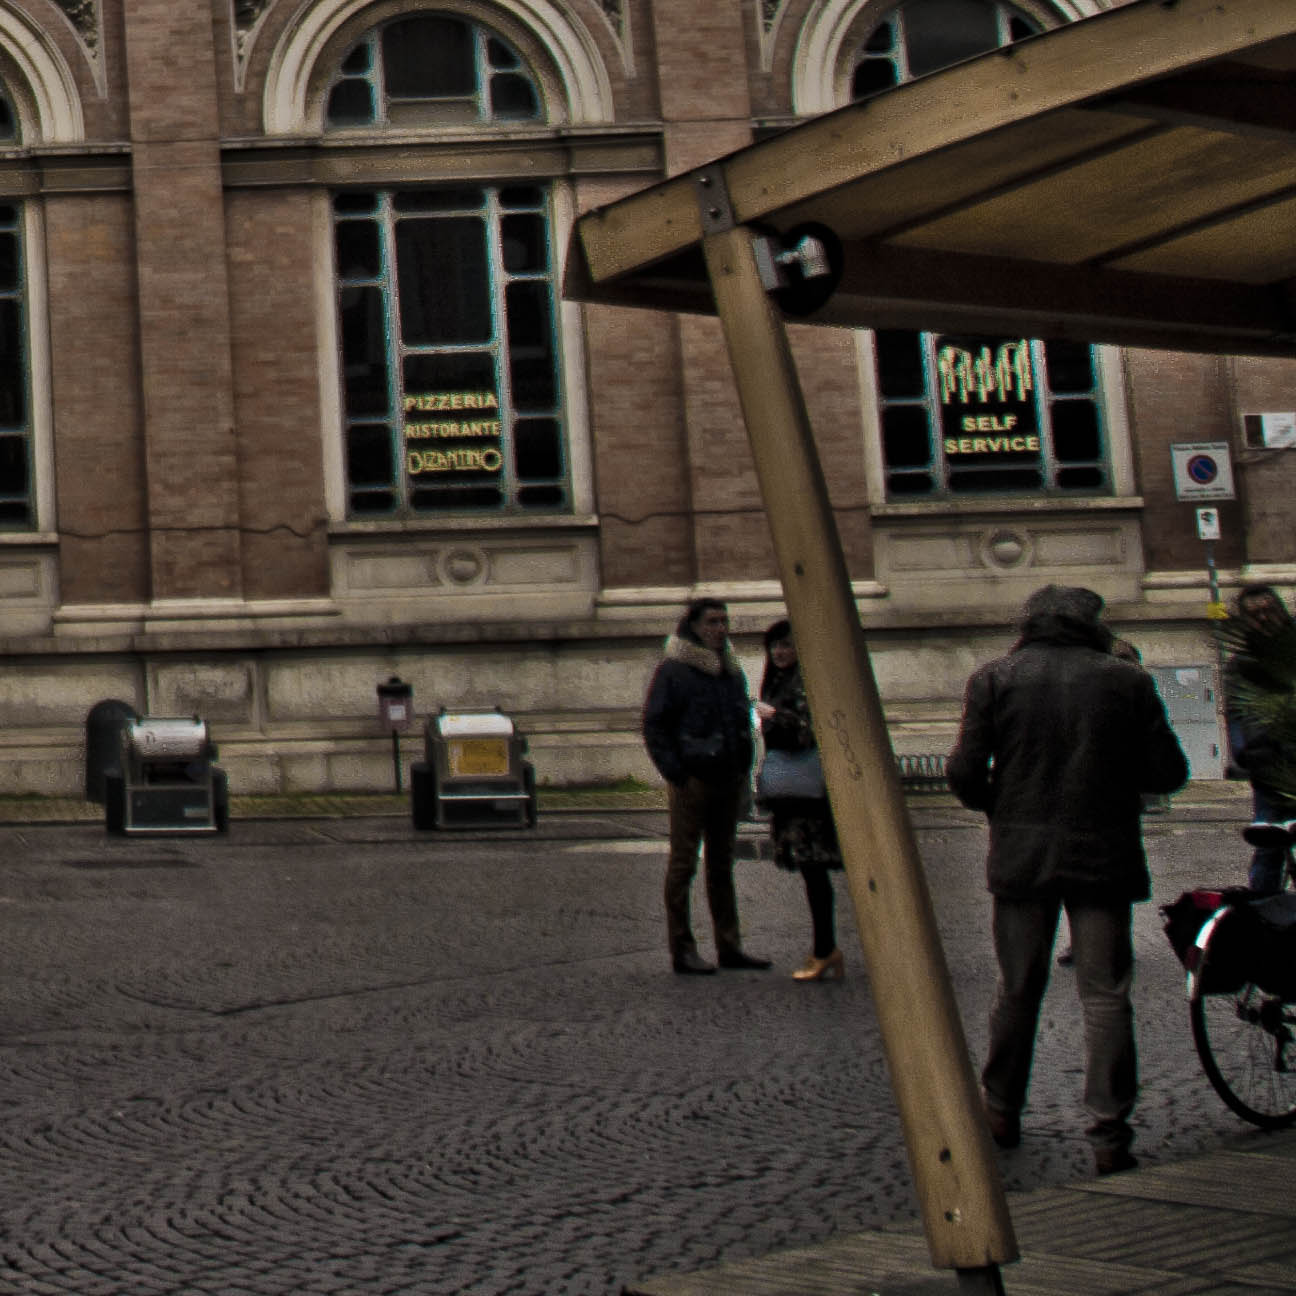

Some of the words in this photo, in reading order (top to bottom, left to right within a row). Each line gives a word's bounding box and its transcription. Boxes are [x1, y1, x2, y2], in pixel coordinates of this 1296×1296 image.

[405, 392, 498, 411] PIZZERIA
[406, 420, 502, 438] RISTORANTE
[961, 415, 1019, 432] SELF
[944, 436, 1040, 454] SERVICE
